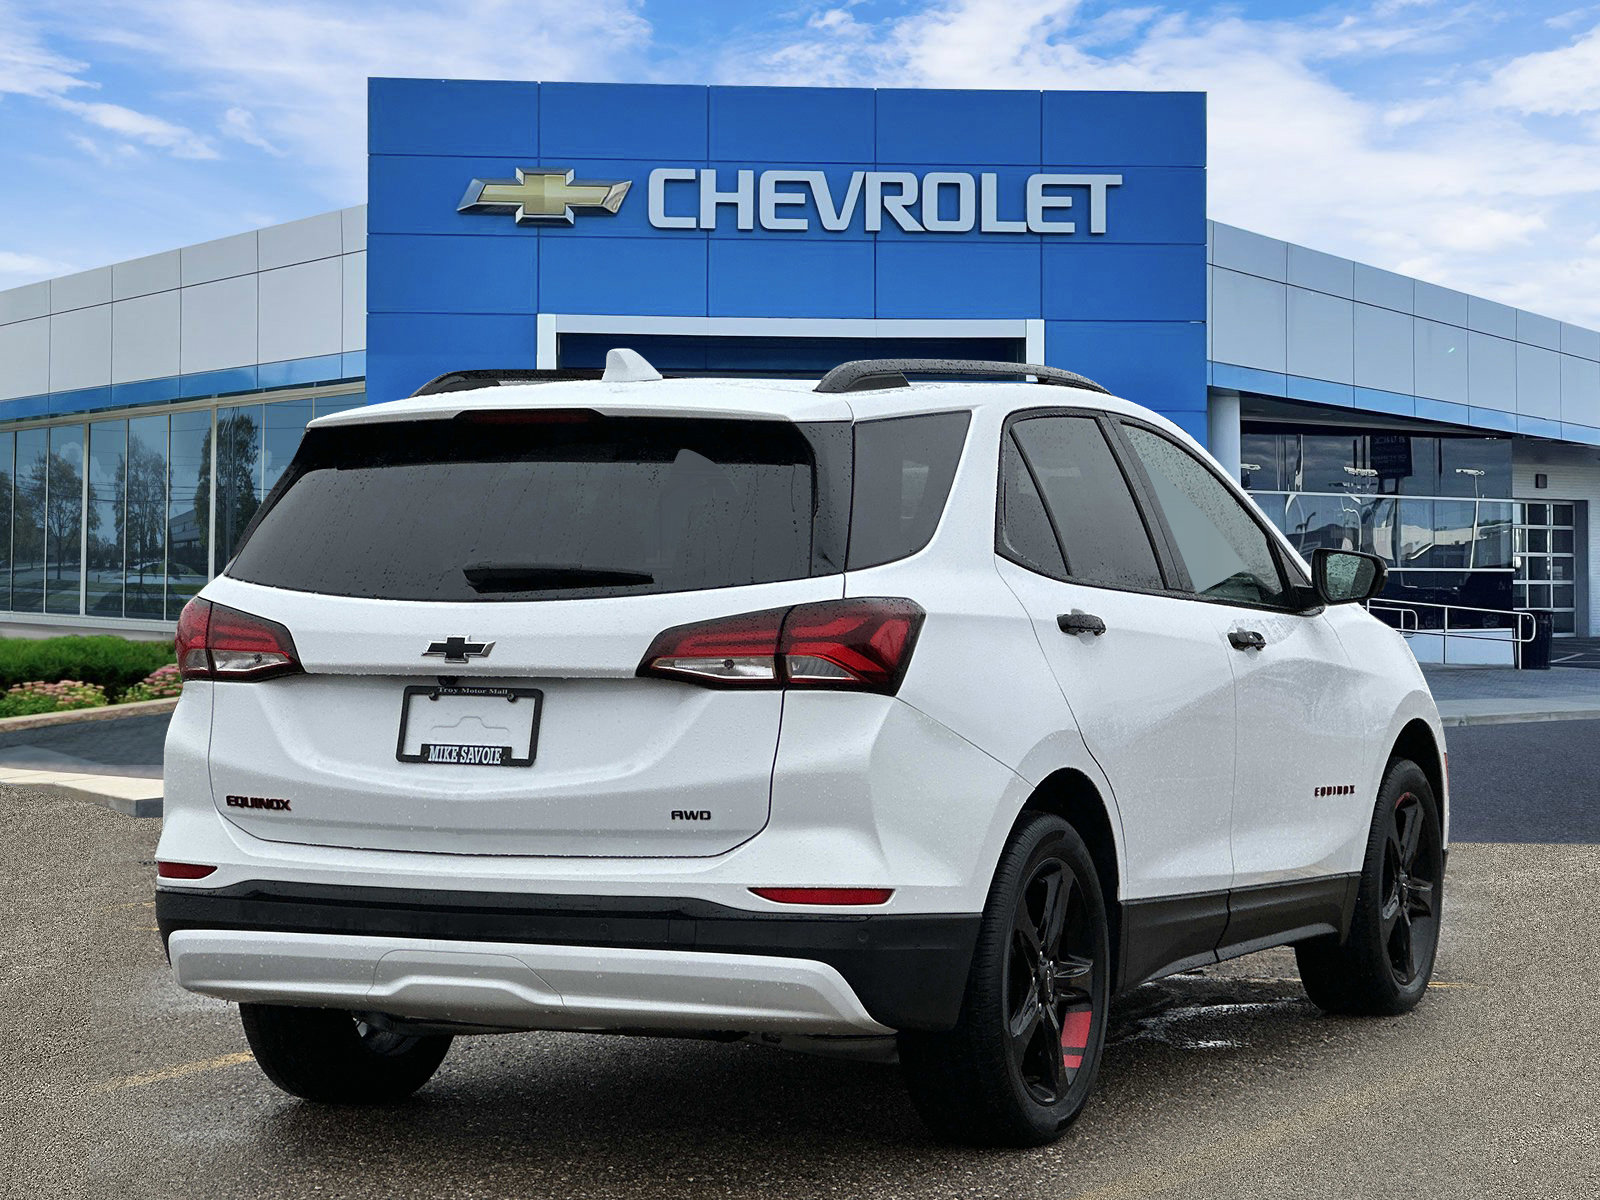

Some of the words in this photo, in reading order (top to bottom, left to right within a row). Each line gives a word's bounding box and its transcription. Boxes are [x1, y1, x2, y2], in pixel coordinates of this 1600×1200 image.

[648, 168, 1123, 234] CHEVROLET
[428, 745, 459, 763] MIKE
[460, 746, 502, 765] SAVOIE
[1314, 785, 1355, 797] EQUINOX
[226, 795, 292, 811] EQUINOX
[671, 810, 711, 820] AWD
